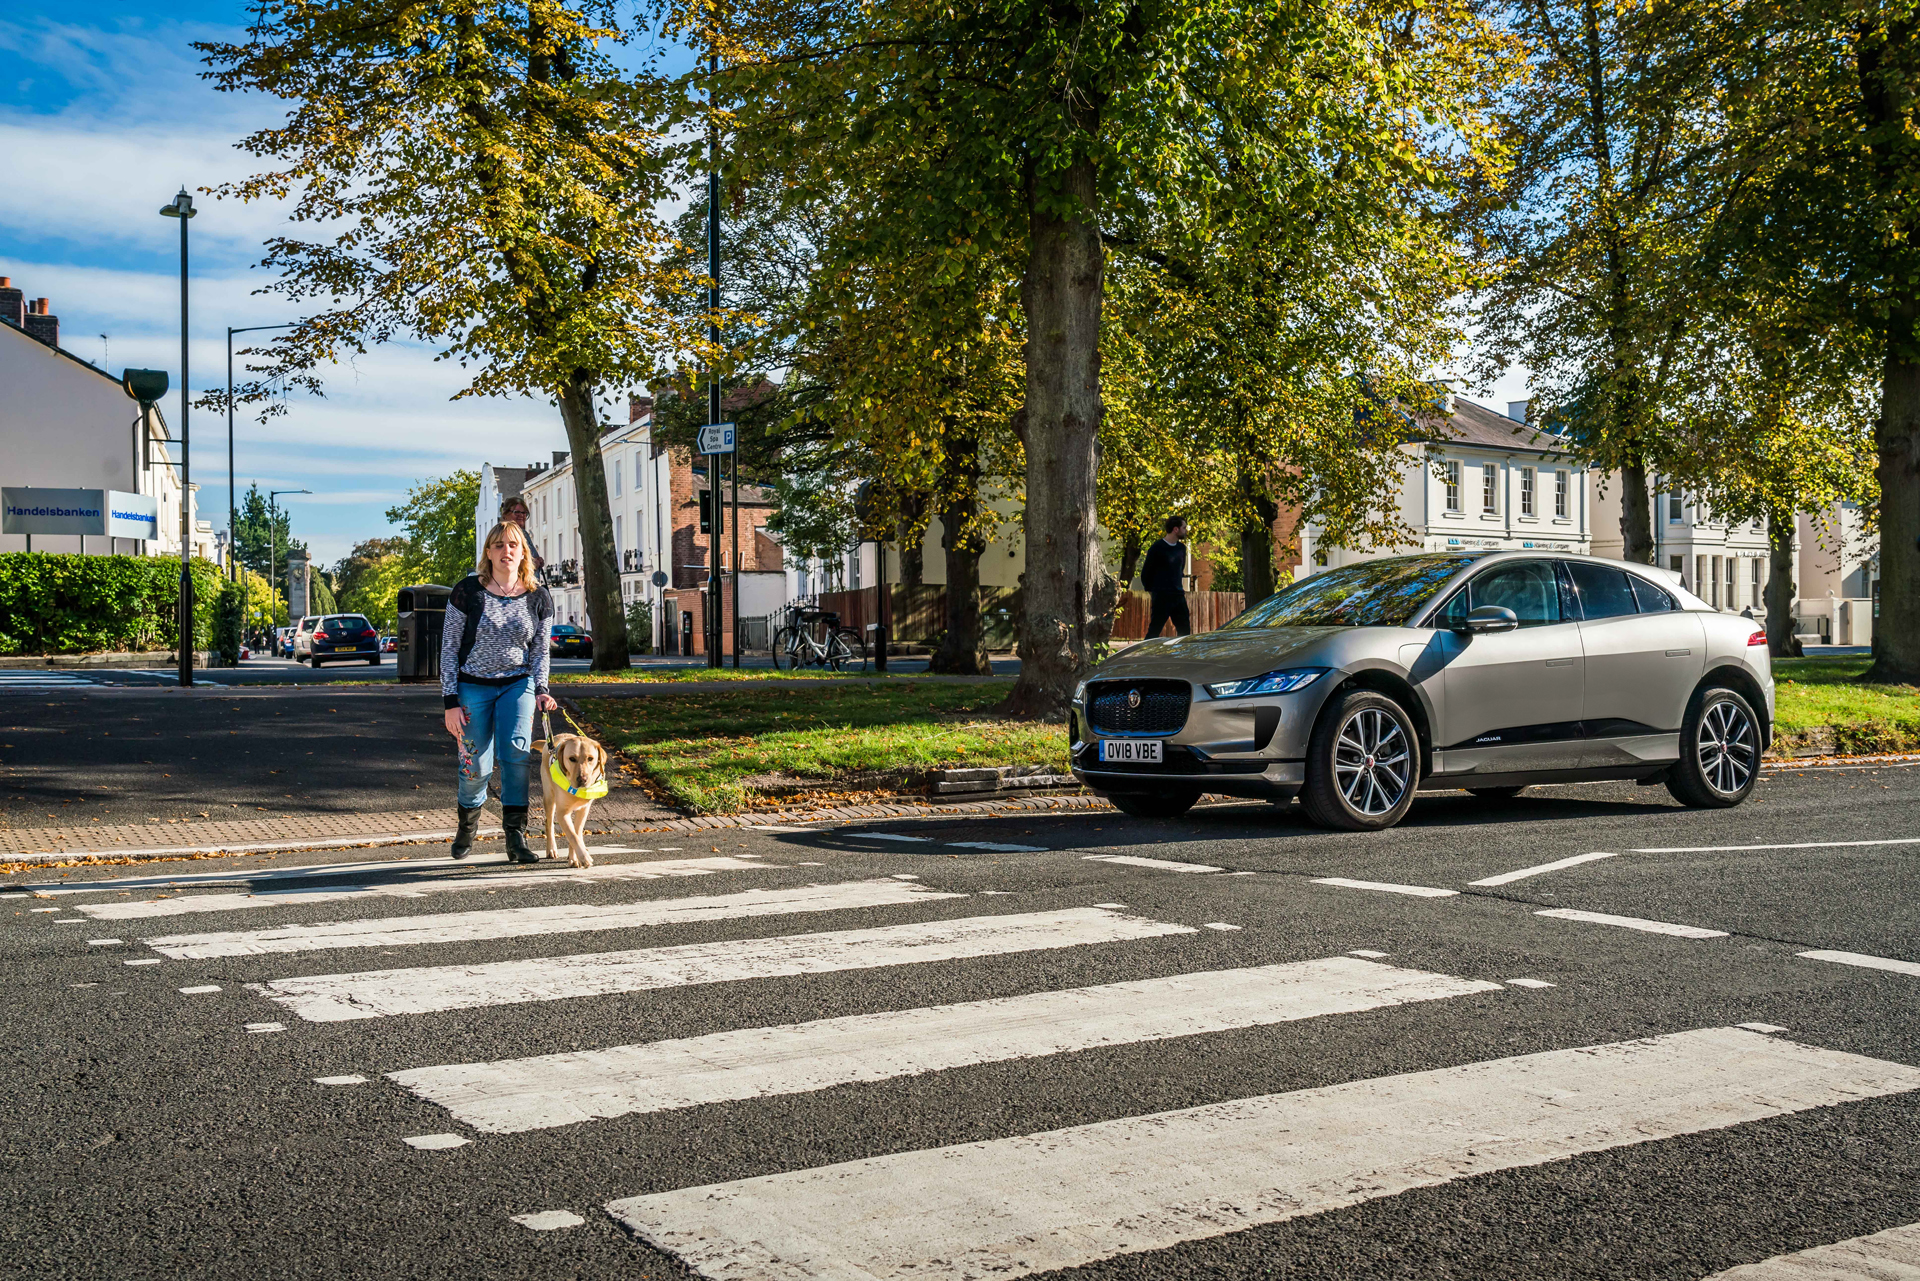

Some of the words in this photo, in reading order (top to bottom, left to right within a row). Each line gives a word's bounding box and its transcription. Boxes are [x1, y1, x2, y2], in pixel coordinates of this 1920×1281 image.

[708, 427, 721, 435] Royal
[7, 506, 100, 517] Handelsbanken
[111, 509, 156, 523] Handelsbanken
[1108, 743, 1132, 758] OV18
[1135, 743, 1157, 759] VBE
